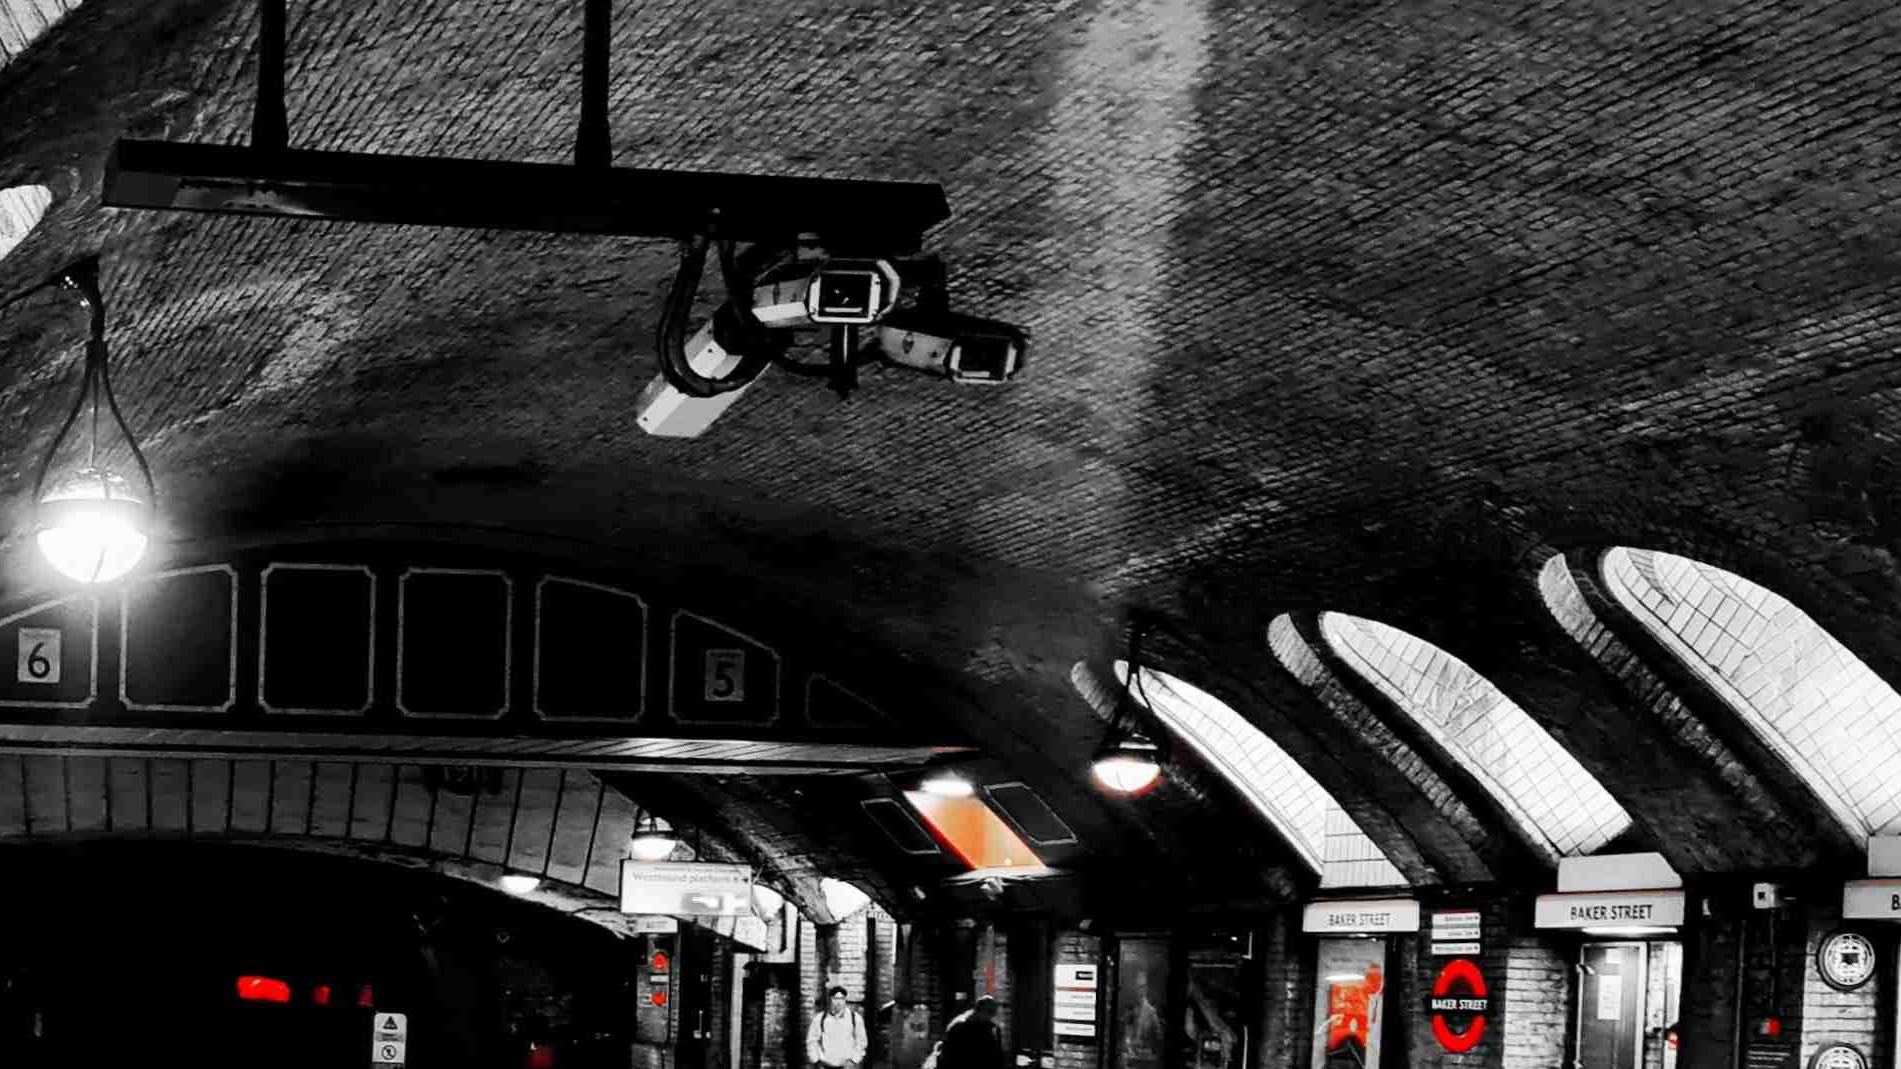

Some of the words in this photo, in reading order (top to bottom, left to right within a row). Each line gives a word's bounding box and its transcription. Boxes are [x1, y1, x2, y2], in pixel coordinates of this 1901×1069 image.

[27, 641, 51, 679] 6
[712, 661, 735, 698] 5
[1328, 913, 1357, 927] BAKER
[1359, 912, 1391, 927] STREET
[1571, 905, 1608, 921] BAKER
[1611, 904, 1653, 920] STREET
